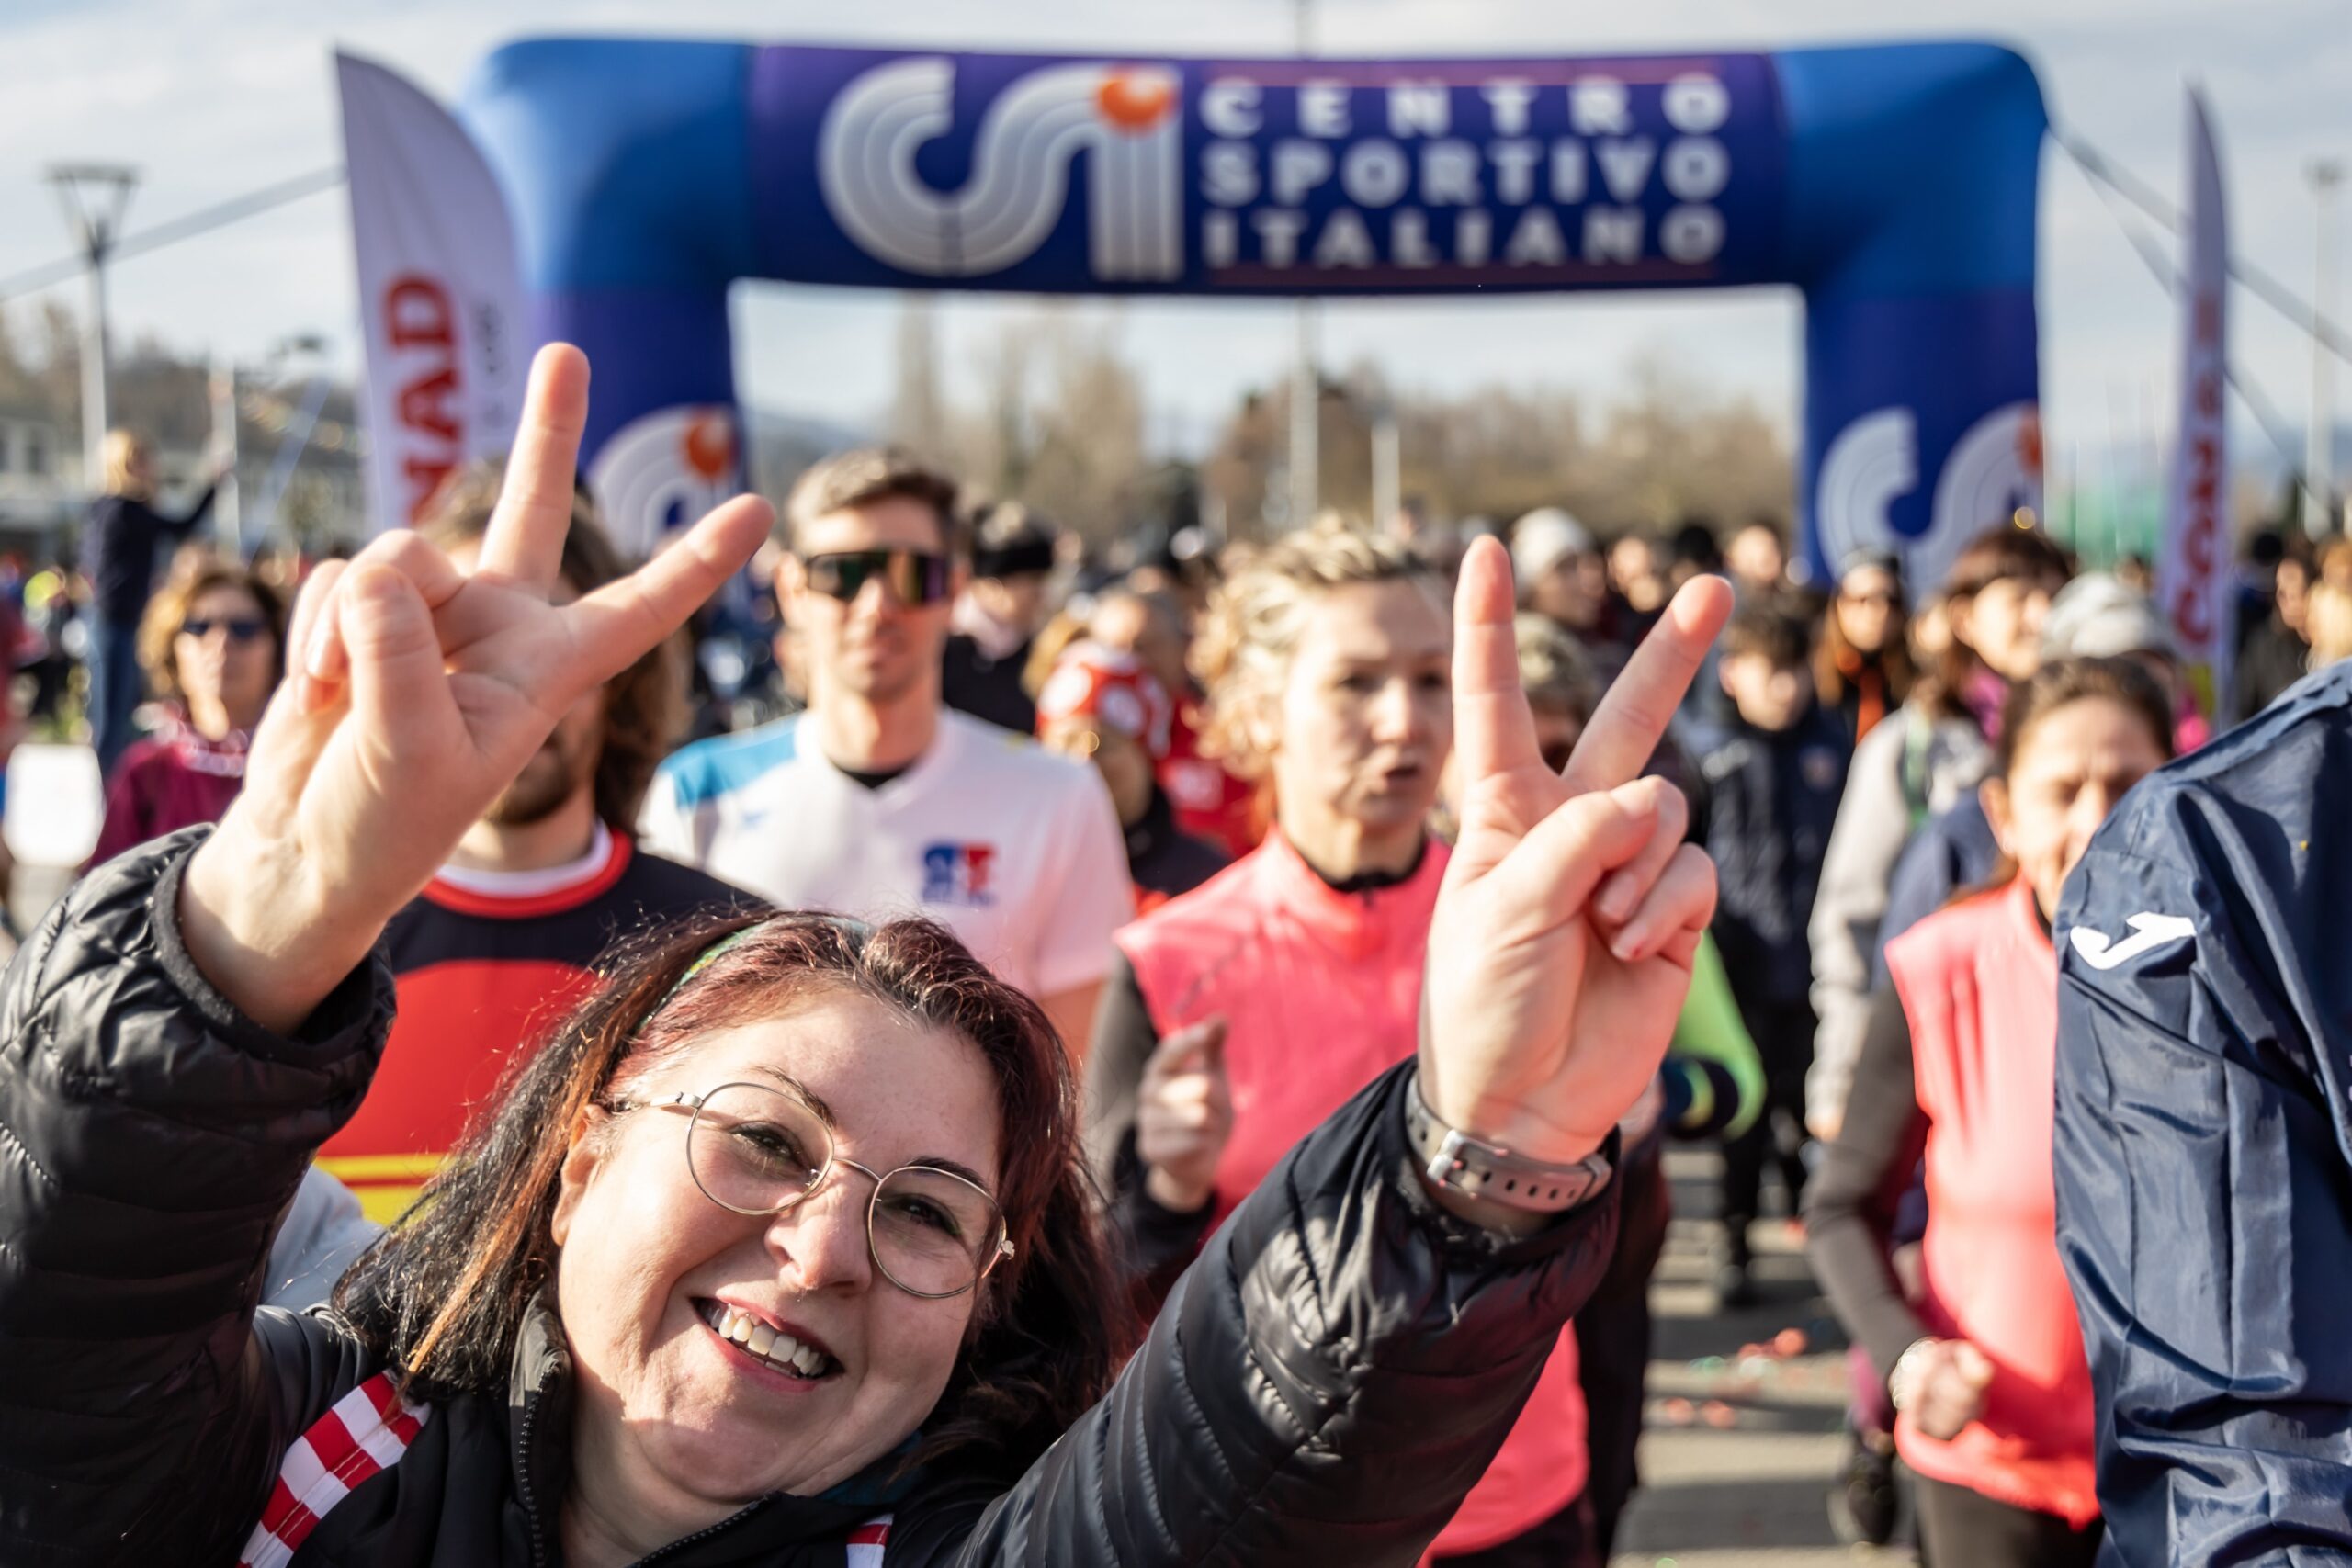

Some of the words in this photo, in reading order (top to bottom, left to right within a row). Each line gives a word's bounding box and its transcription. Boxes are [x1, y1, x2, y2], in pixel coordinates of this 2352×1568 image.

[1201, 73, 1731, 136] CENTRO
[1203, 136, 1731, 204] SPORTIVO
[1203, 206, 1725, 267] ITALIANO
